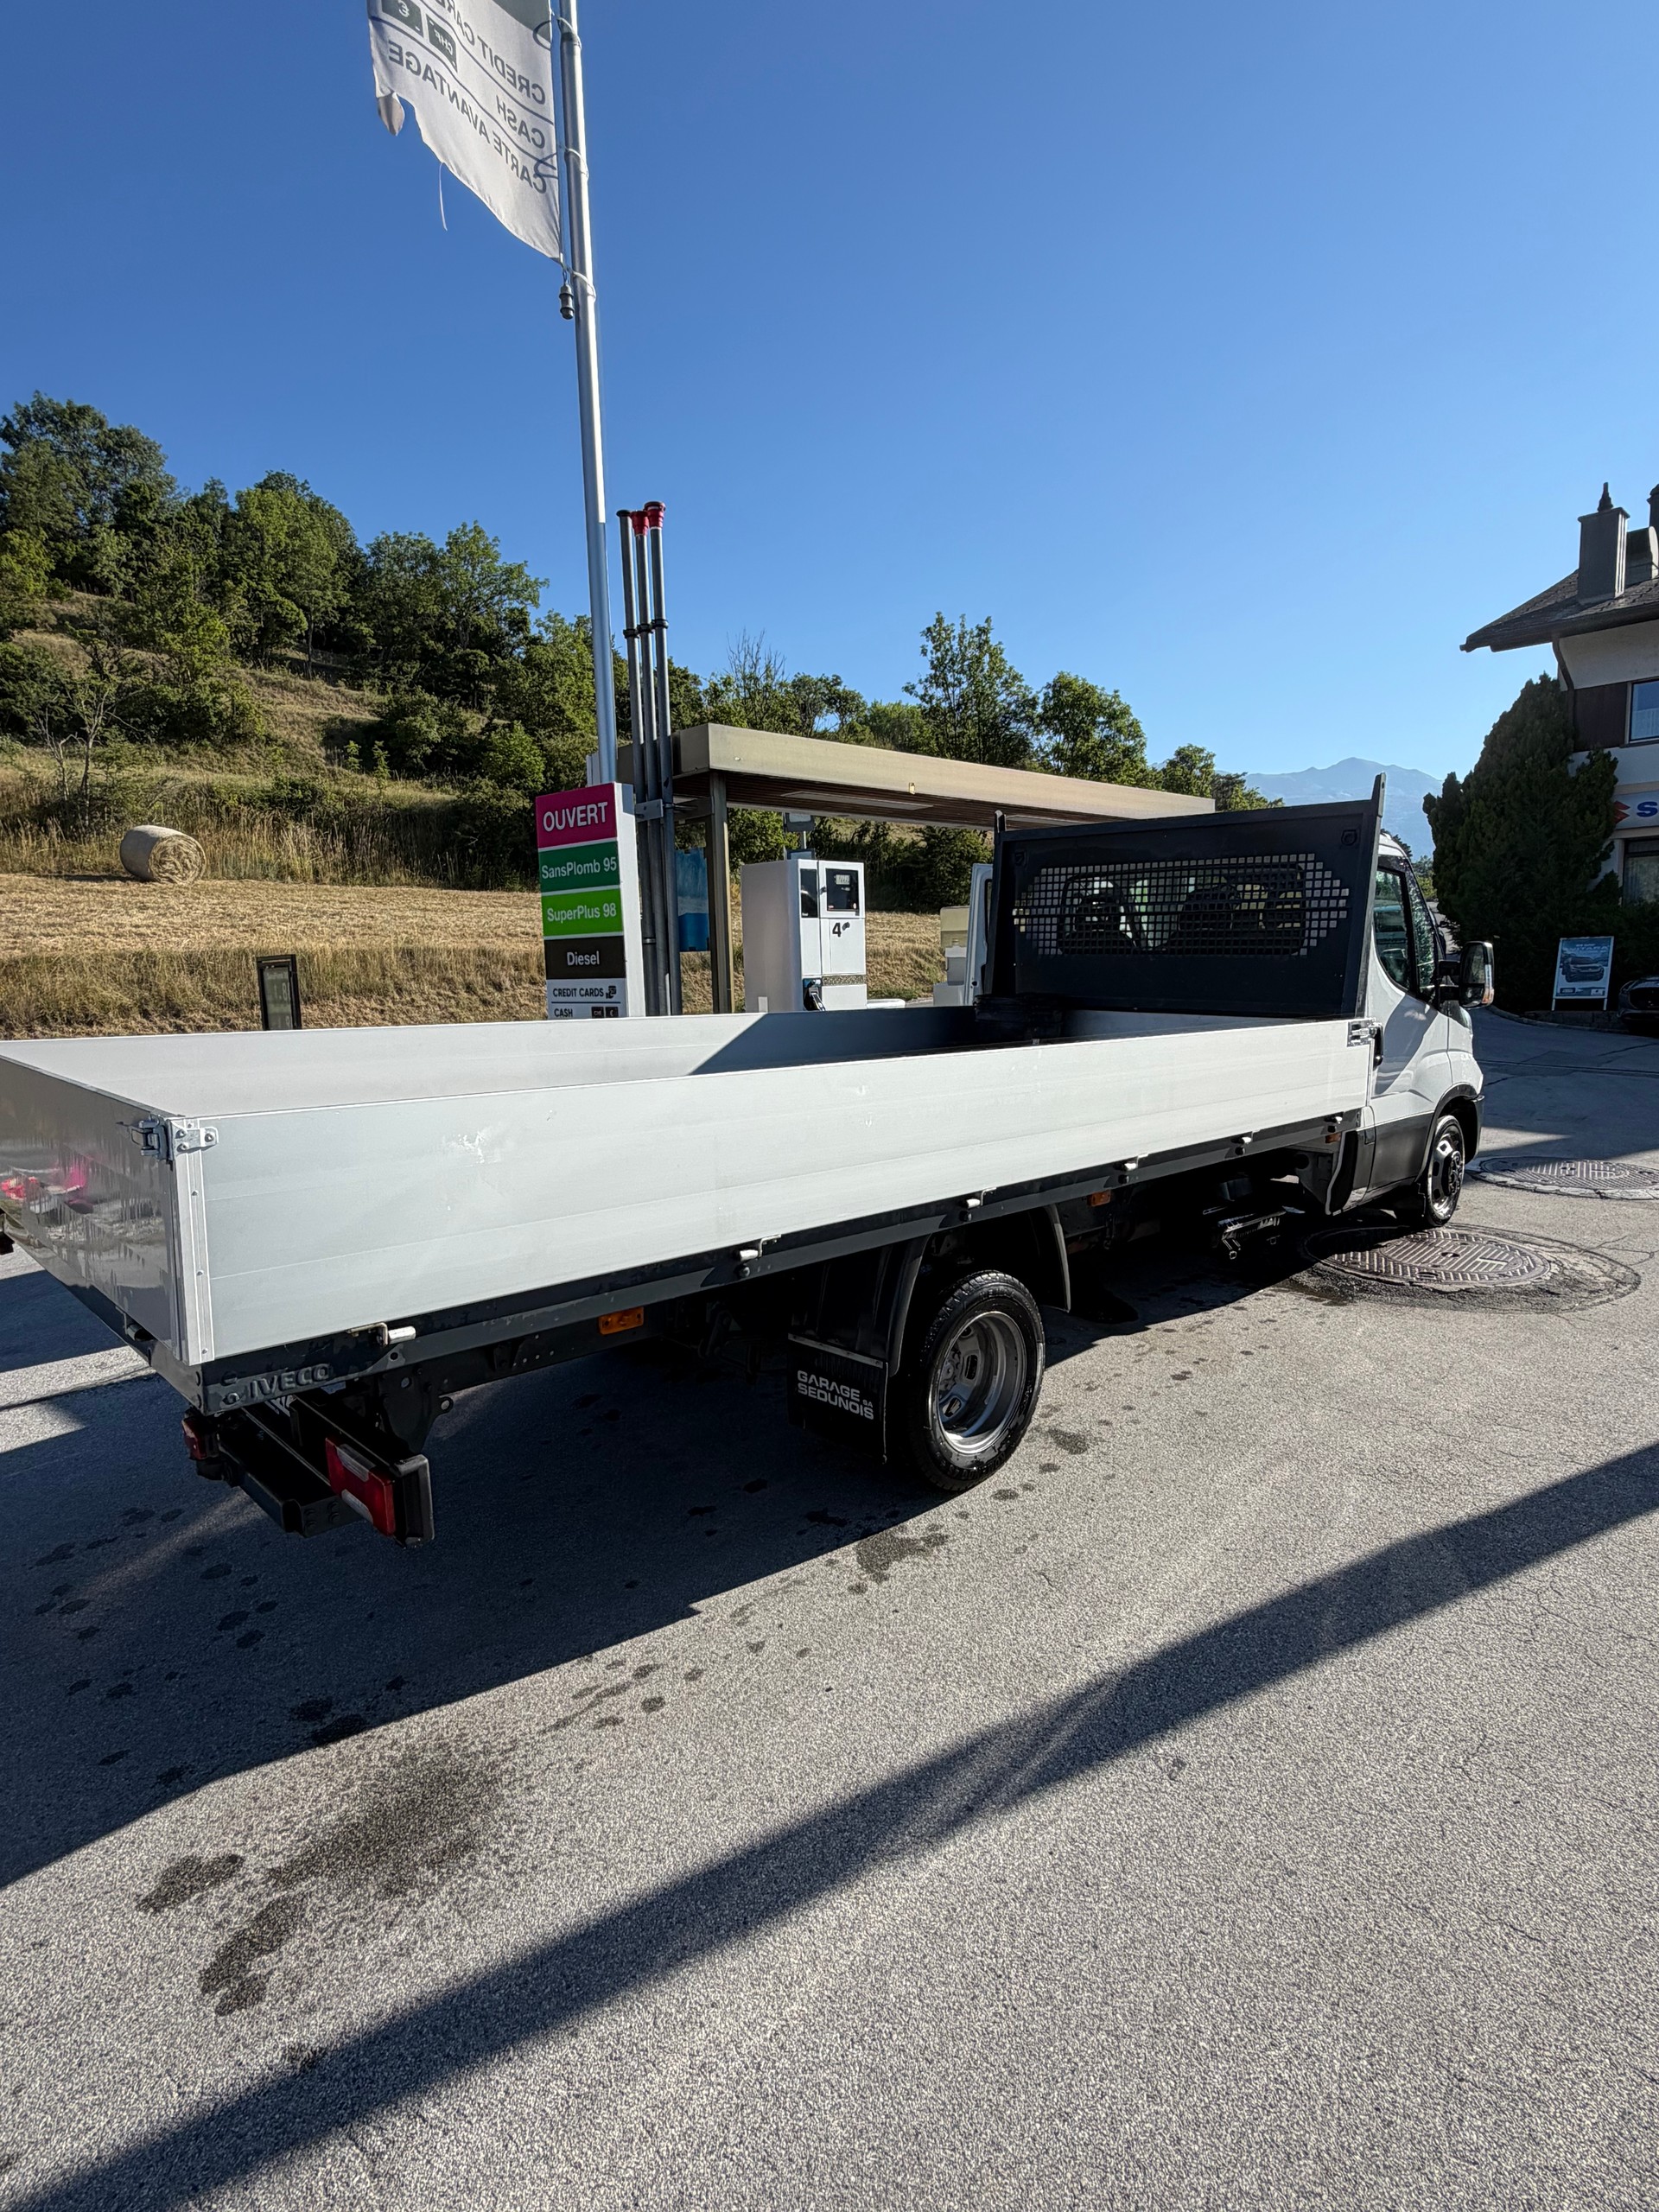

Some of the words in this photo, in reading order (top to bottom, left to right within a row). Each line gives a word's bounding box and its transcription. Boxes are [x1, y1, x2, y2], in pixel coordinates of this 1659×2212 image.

[543, 801, 608, 832] OUVERT
[541, 858, 601, 879] SansPlomb
[602, 856, 617, 872] 95
[547, 905, 601, 924] SuperPlus
[602, 903, 617, 918] 98
[832, 922, 842, 938] 4
[566, 950, 600, 966] Diesel
[552, 988, 577, 997] CREDIT
[579, 988, 604, 997] CARDS
[554, 1007, 573, 1018] CASH
[250, 1363, 331, 1398] IVECO
[797, 1370, 861, 1402] GARAGE
[798, 1382, 874, 1421] SEDUNOIS
